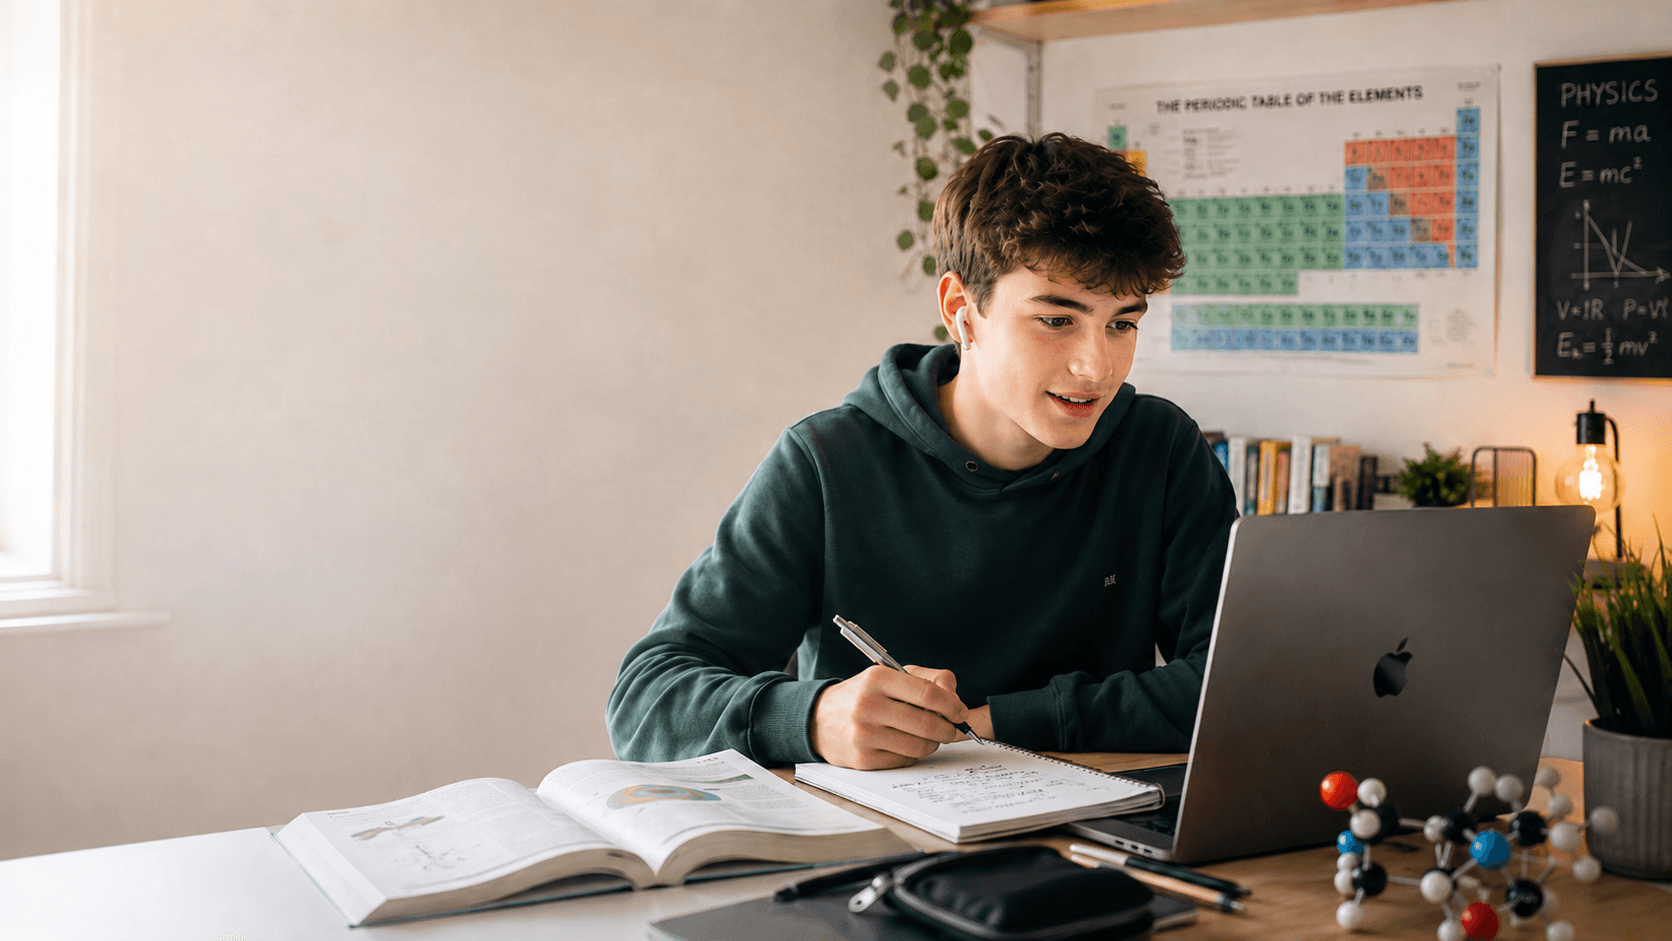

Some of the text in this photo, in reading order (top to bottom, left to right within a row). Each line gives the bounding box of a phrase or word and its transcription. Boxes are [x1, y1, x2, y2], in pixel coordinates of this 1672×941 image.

[1156, 84, 1424, 114] THE PERIODIC TABLE OF THE ELEMENTS
[1561, 79, 1659, 109] PHYSICS
[1561, 120, 1580, 149] F
[1608, 125, 1652, 144] ma
[1559, 161, 1578, 188] E
